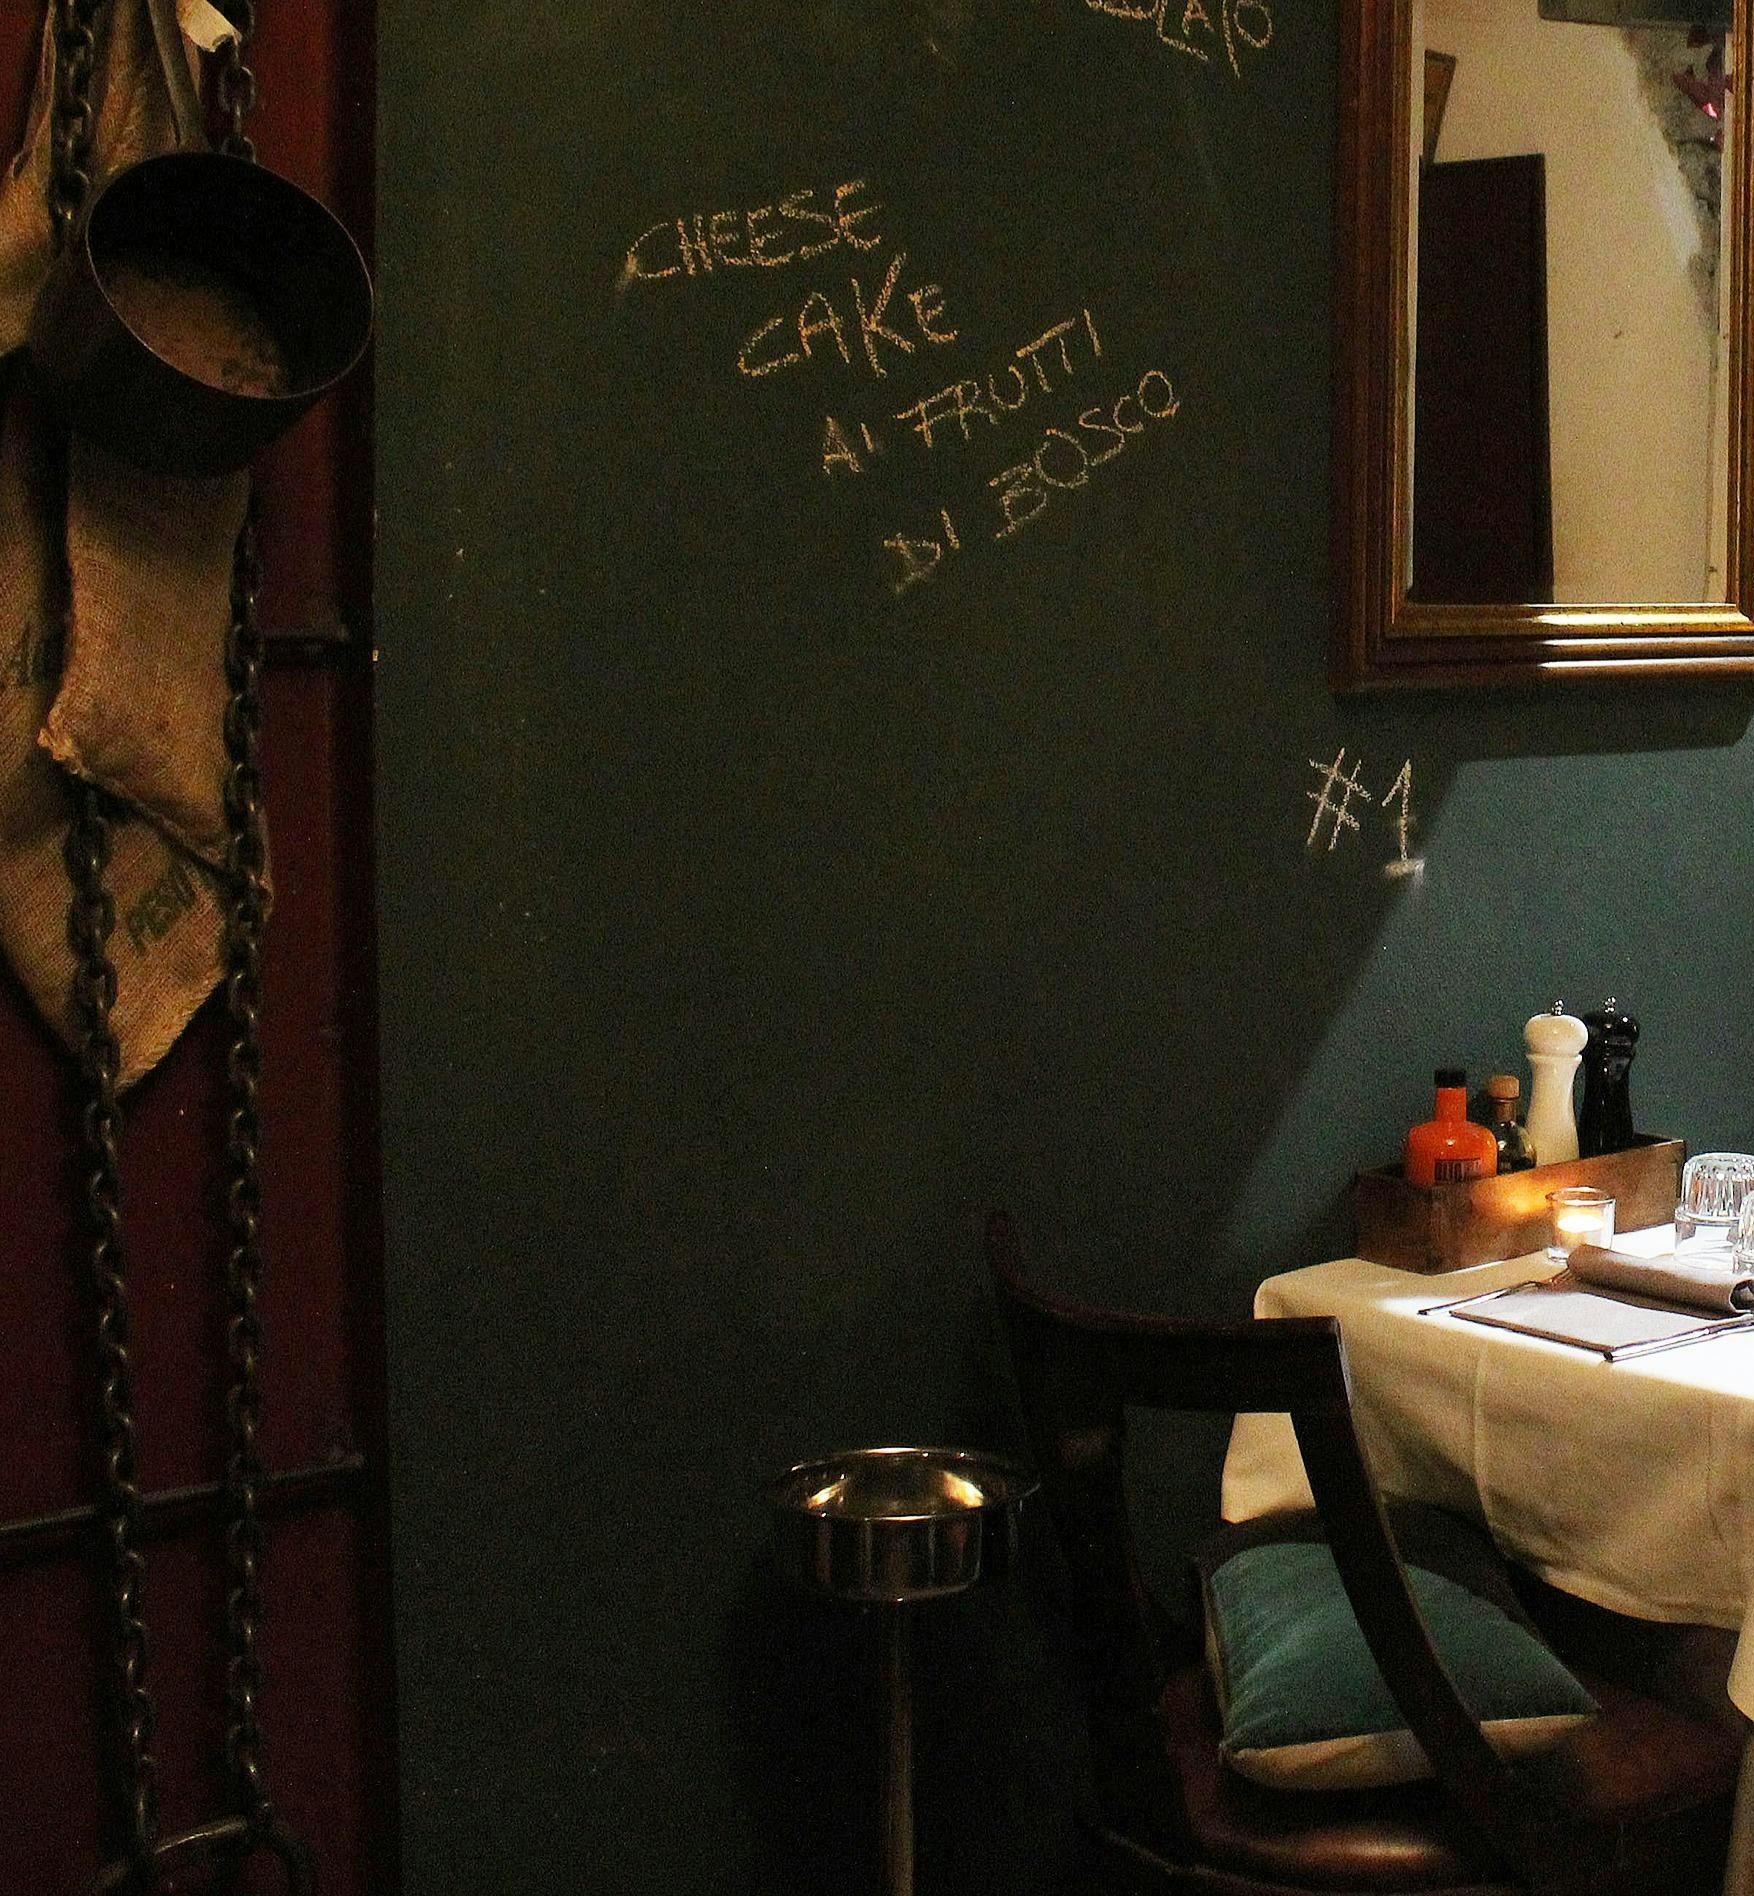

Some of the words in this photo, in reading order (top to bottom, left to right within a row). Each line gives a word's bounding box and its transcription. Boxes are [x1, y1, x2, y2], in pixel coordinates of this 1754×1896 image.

[621, 180, 885, 284] CHEESE
[737, 252, 959, 379] CAKE
[822, 415, 877, 477] AI
[893, 307, 1102, 449] FRUTTI
[883, 508, 961, 594] DI
[988, 369, 1181, 542] BOSCO
[1308, 747, 1425, 879] #1
